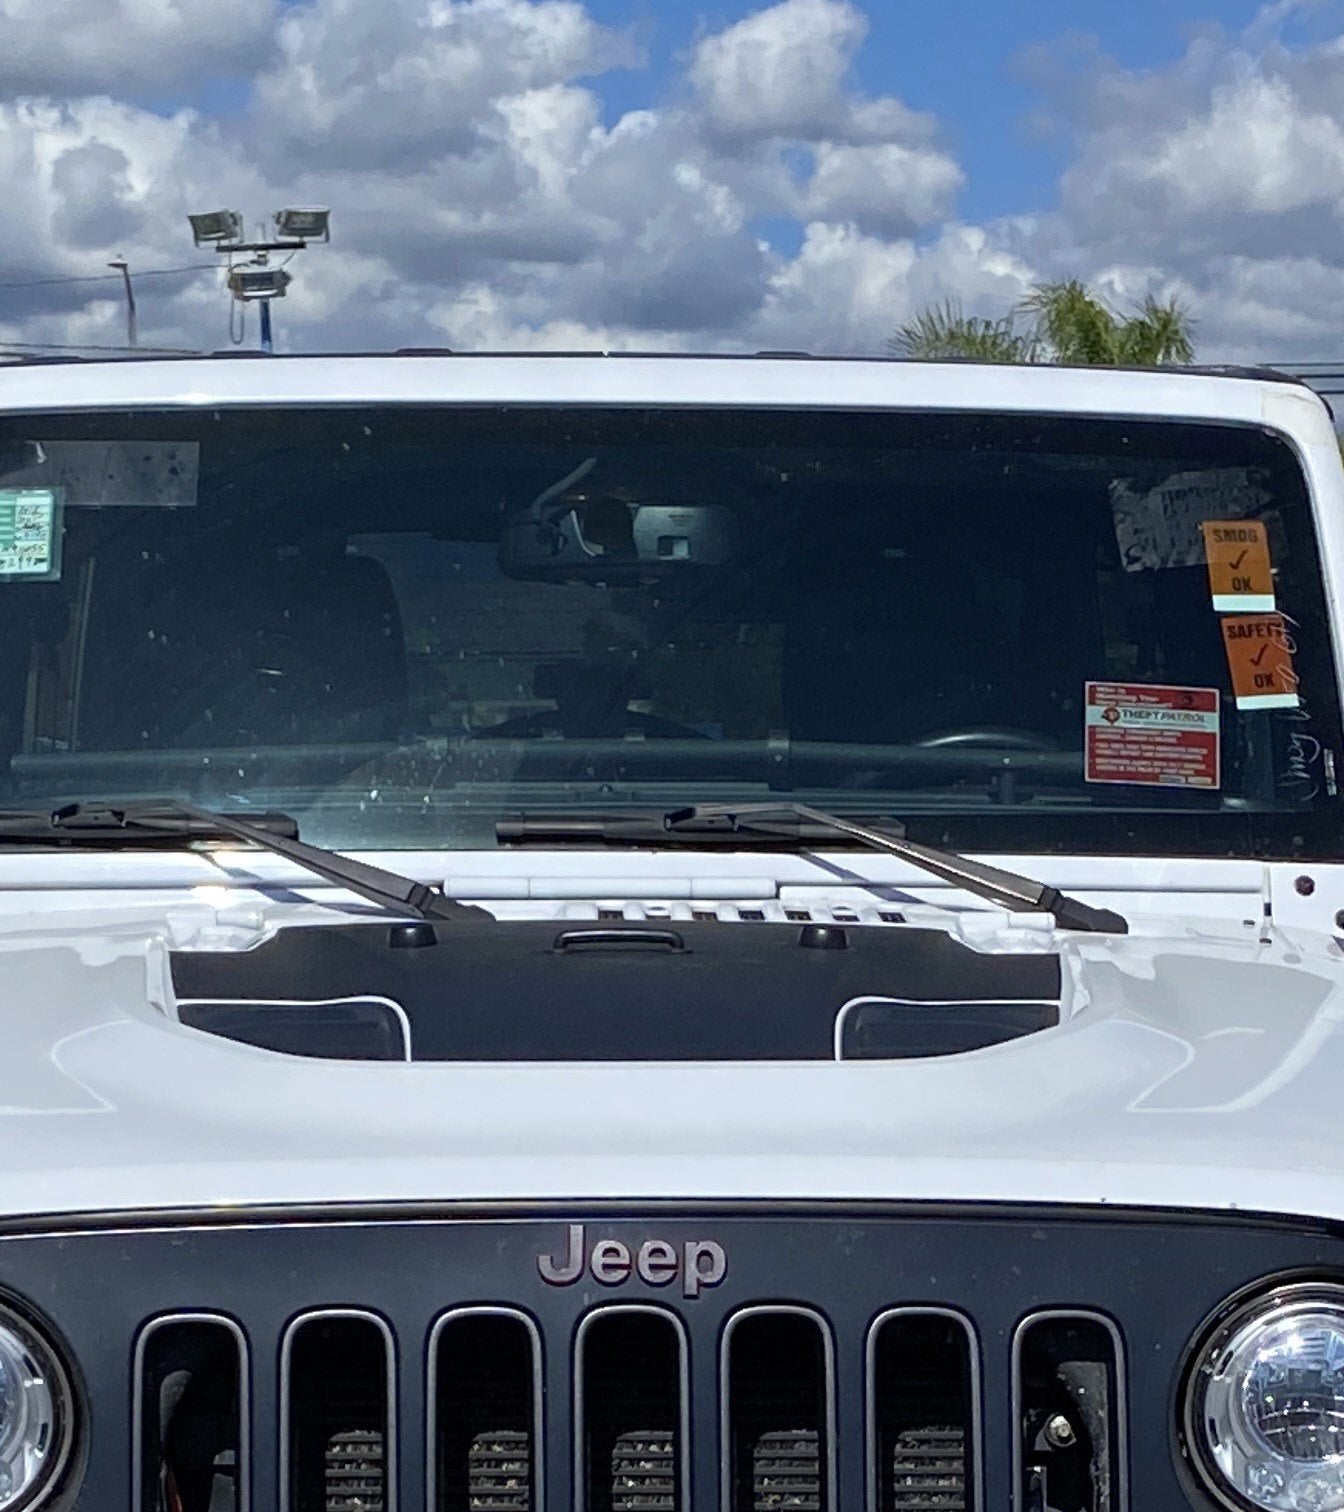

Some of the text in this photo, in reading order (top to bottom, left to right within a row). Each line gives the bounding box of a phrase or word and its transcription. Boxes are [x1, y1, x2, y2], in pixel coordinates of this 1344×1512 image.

[1213, 528, 1259, 543] SMOG
[1231, 575, 1253, 592] OK
[1253, 672, 1276, 688] OK
[537, 1224, 728, 1300] Jeep
